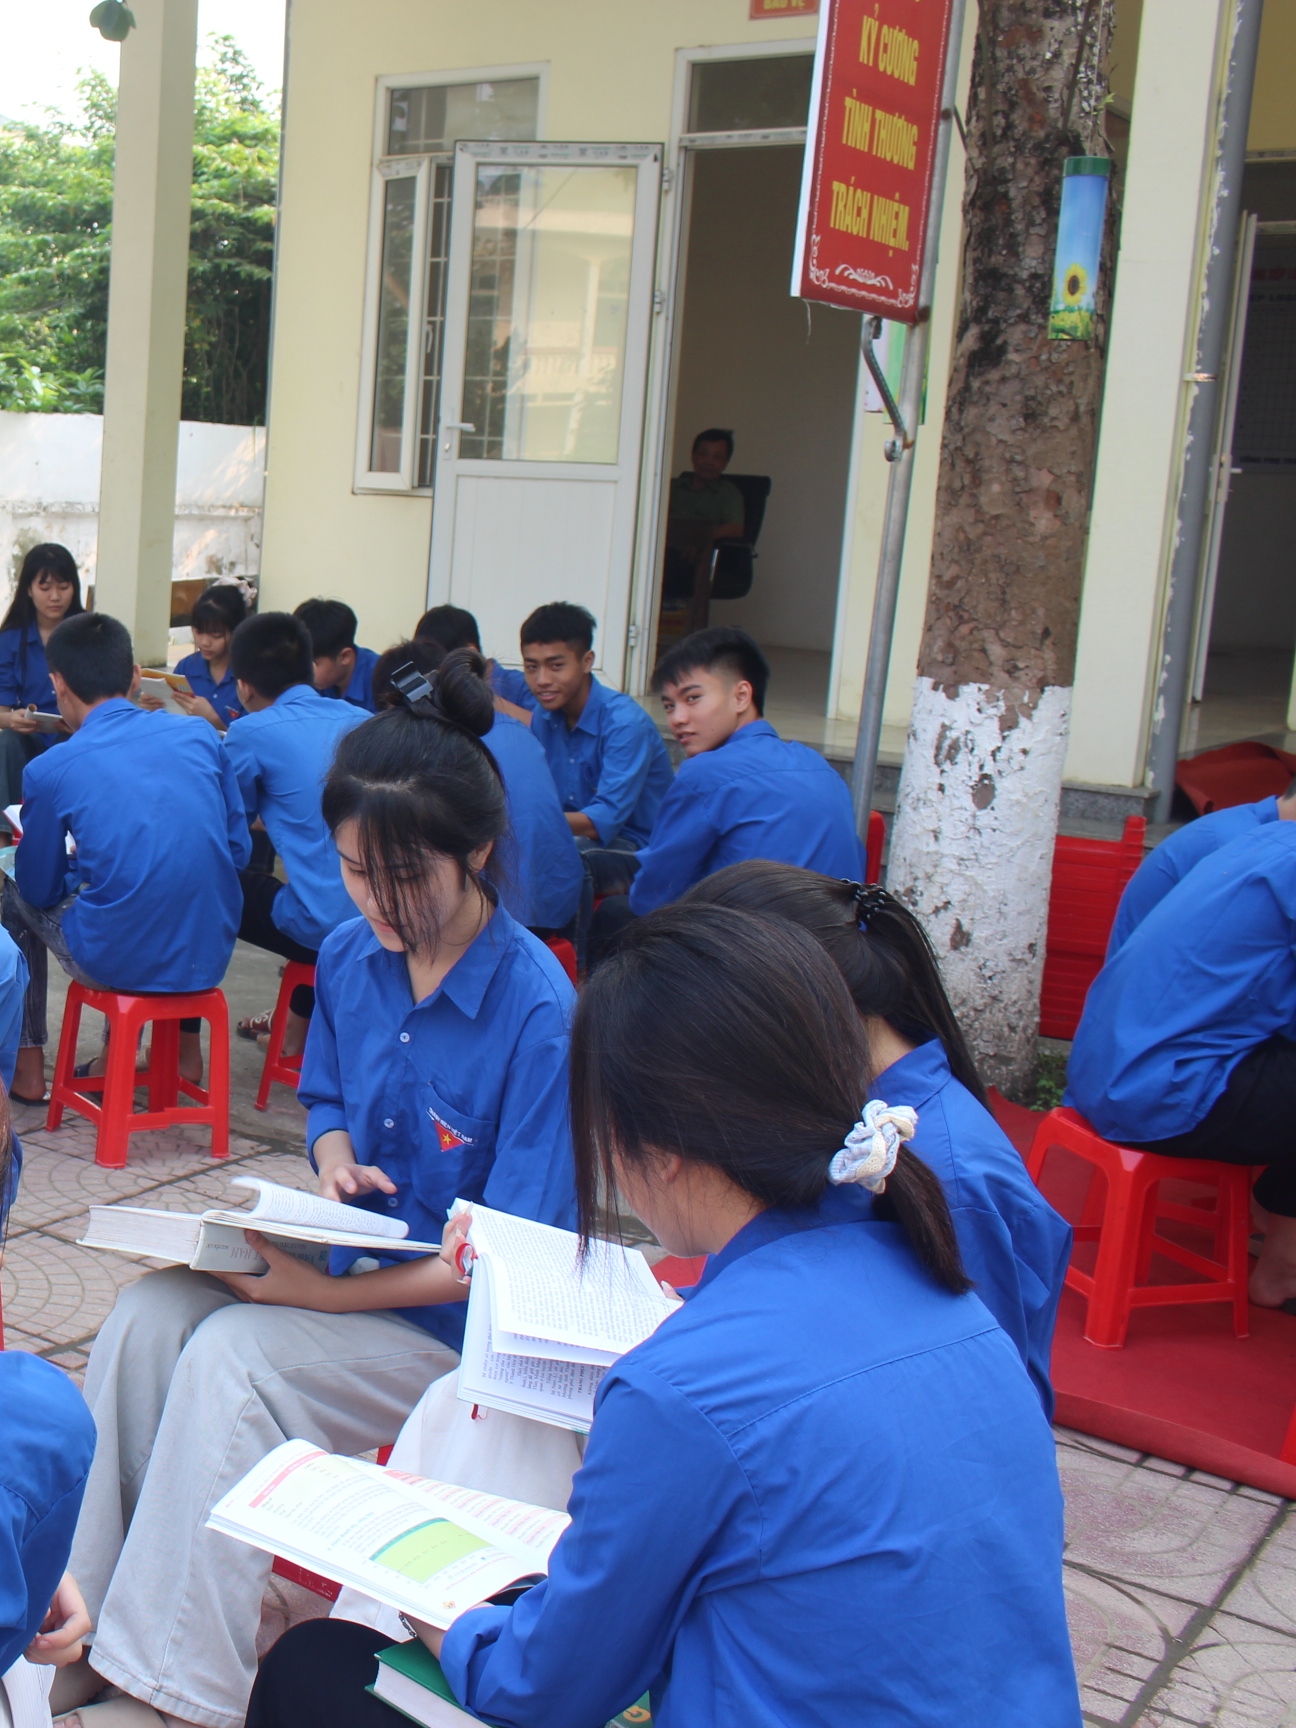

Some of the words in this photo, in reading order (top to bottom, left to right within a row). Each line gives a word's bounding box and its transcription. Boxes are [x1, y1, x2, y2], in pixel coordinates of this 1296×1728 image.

[859, 3, 879, 67] KỶ
[878, 24, 920, 86] CƯƠNG
[842, 88, 873, 153] TÌNH
[872, 108, 919, 171] THƯƠNG
[830, 176, 871, 238] TRÁCH
[869, 192, 910, 257] NHIỆM.
